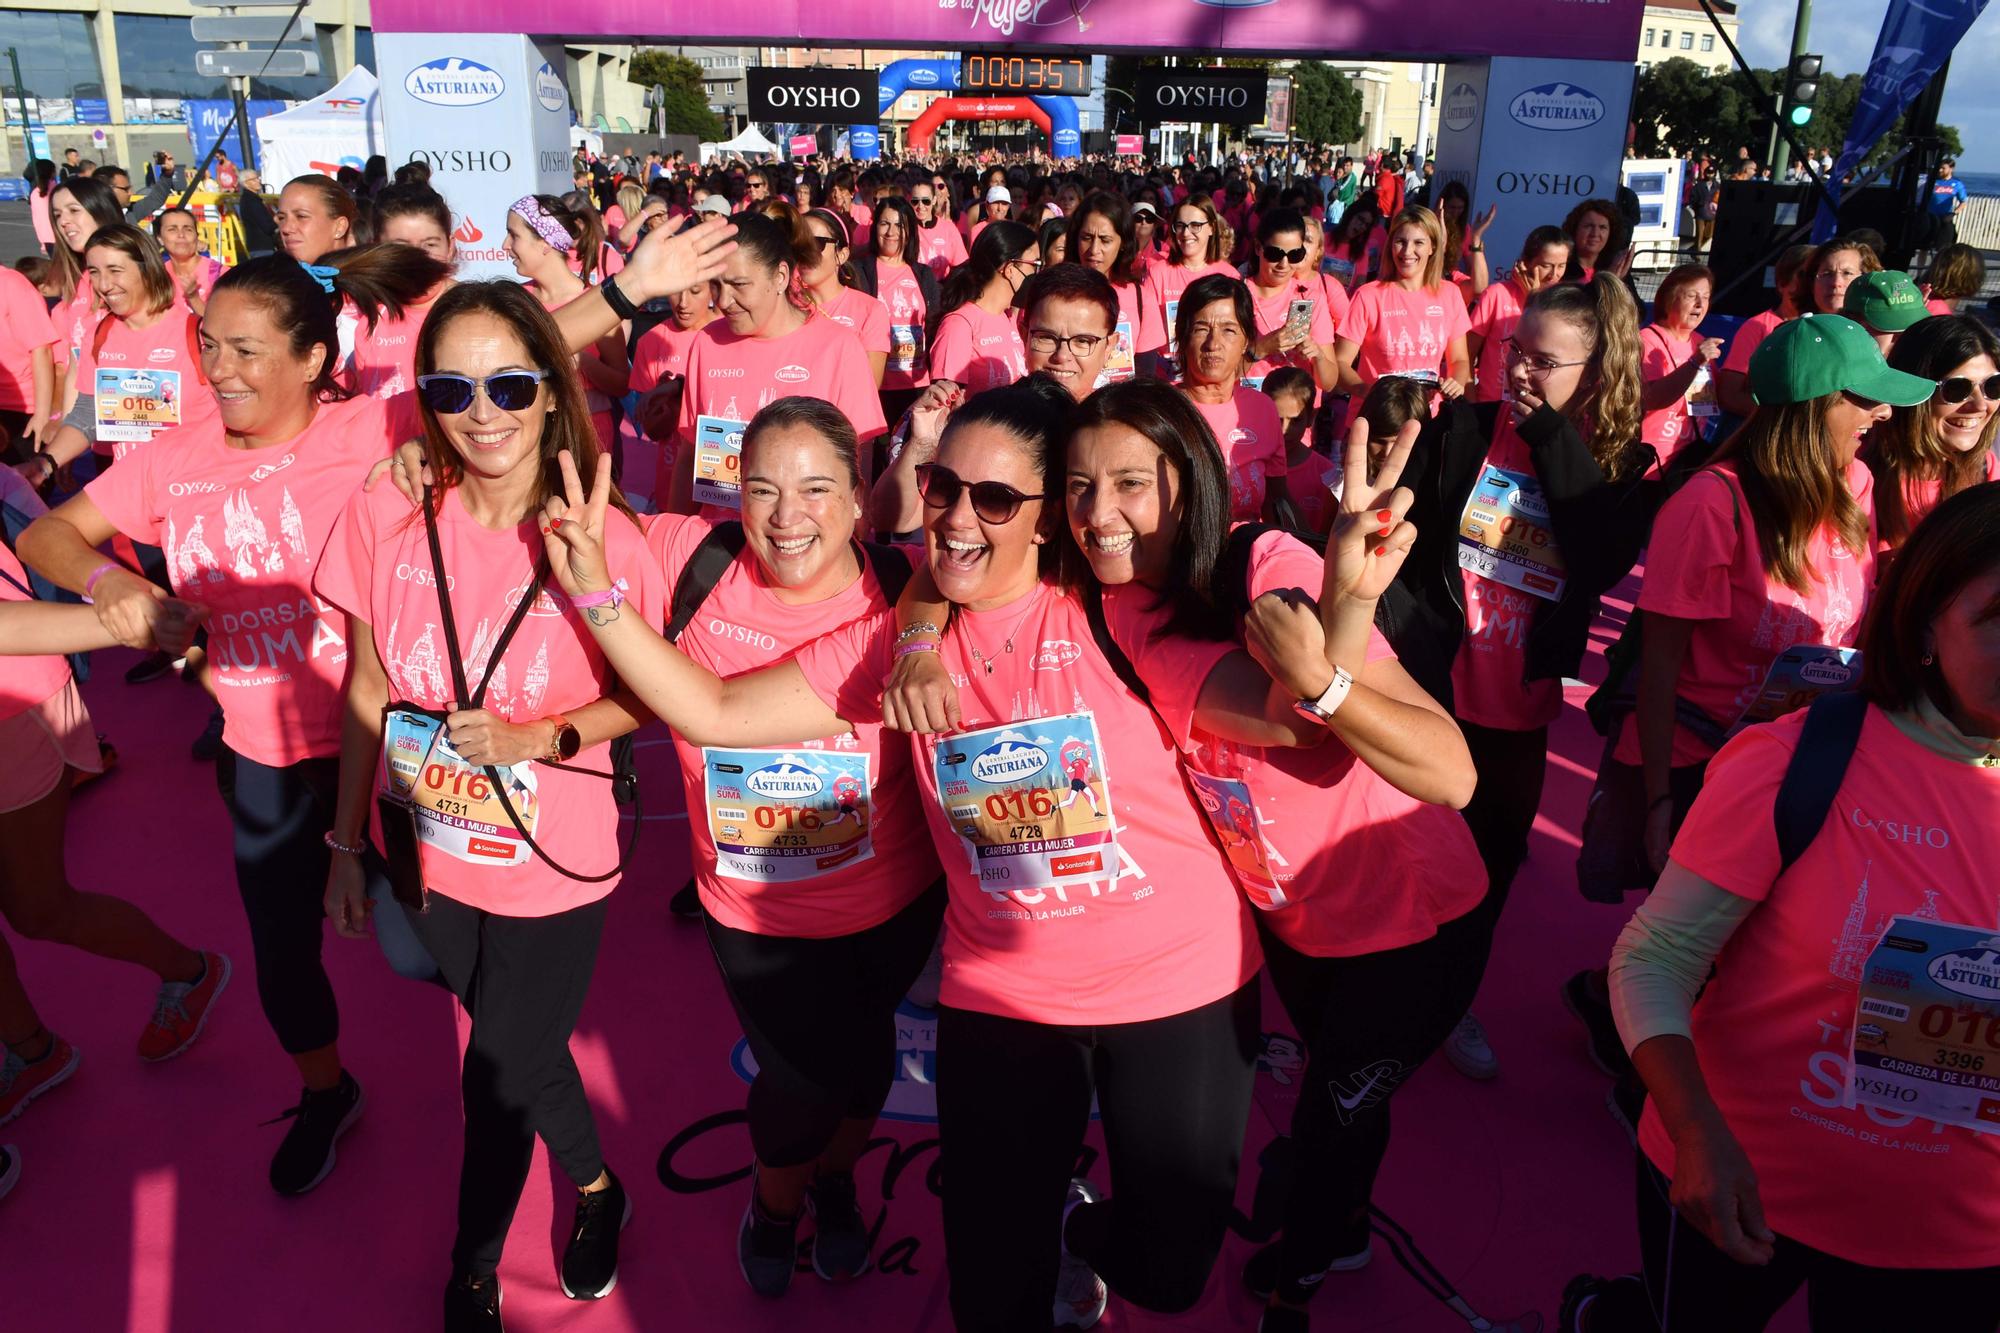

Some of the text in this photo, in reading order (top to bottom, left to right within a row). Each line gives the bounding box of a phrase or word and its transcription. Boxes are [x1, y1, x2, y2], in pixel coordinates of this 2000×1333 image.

[969, 56, 1084, 89] 00:03:57
[413, 76, 498, 95] ASTURIANA
[767, 86, 861, 108] OYSHO
[1156, 85, 1248, 108] OYSHO
[1515, 99, 1597, 121] ASTURIANA
[409, 150, 512, 173] OYSHO
[540, 151, 570, 173] OYSHO
[1496, 172, 1595, 197] OYSHO
[455, 247, 511, 262] tander
[708, 368, 745, 378] OYSHO
[777, 371, 807, 379] ASTURIANA
[123, 397, 155, 411] 016
[168, 481, 227, 497] OYSHO
[714, 481, 737, 490] CARRERA
[701, 490, 731, 502] OYSHO
[1499, 516, 1548, 547] 016
[1503, 540, 1530, 556] 3400
[1477, 544, 1548, 573] CARRERA DE LA MUJER
[222, 595, 334, 634] DORSAL
[709, 619, 776, 651] OYSHO
[396, 740, 420, 753] SUMA
[976, 755, 1044, 778] ASTURIANA
[985, 755, 1012, 764] CENTRAL
[424, 763, 490, 800] 016
[752, 777, 818, 792] ASTURIANA
[946, 785, 970, 796] SUMA
[717, 790, 741, 800] SUMA
[436, 798, 468, 816] 4731
[985, 787, 1051, 822] 016
[416, 805, 498, 835] ARRERA DE LA MUJER
[754, 806, 820, 830] 016
[1010, 825, 1042, 840] 4728
[1853, 808, 1950, 849] OYSHO
[481, 844, 510, 854] Santander
[773, 835, 808, 846] 4733
[984, 838, 1075, 857] CARRERA DE LA MUJER
[743, 844, 840, 856] CARRERA DE LA MUJER
[730, 860, 776, 874] OYSHO
[1064, 858, 1095, 870] Santander
[980, 866, 1010, 881] YSHO
[1132, 885, 1155, 902] 2022
[987, 910, 1022, 920] CARRERA
[1036, 911, 1049, 920] LA
[1050, 905, 1086, 918] MUJER
[1870, 975, 1910, 990] SUMA
[1934, 1049, 1985, 1071] 3396
[1880, 1057, 1938, 1080] CARRERA
[1942, 1071, 1958, 1083] DE
[1961, 1075, 1976, 1086] LA
[1855, 1077, 1919, 1102] YSHO
[1790, 1106, 1950, 1153] CARRERA DE LA MUJER
